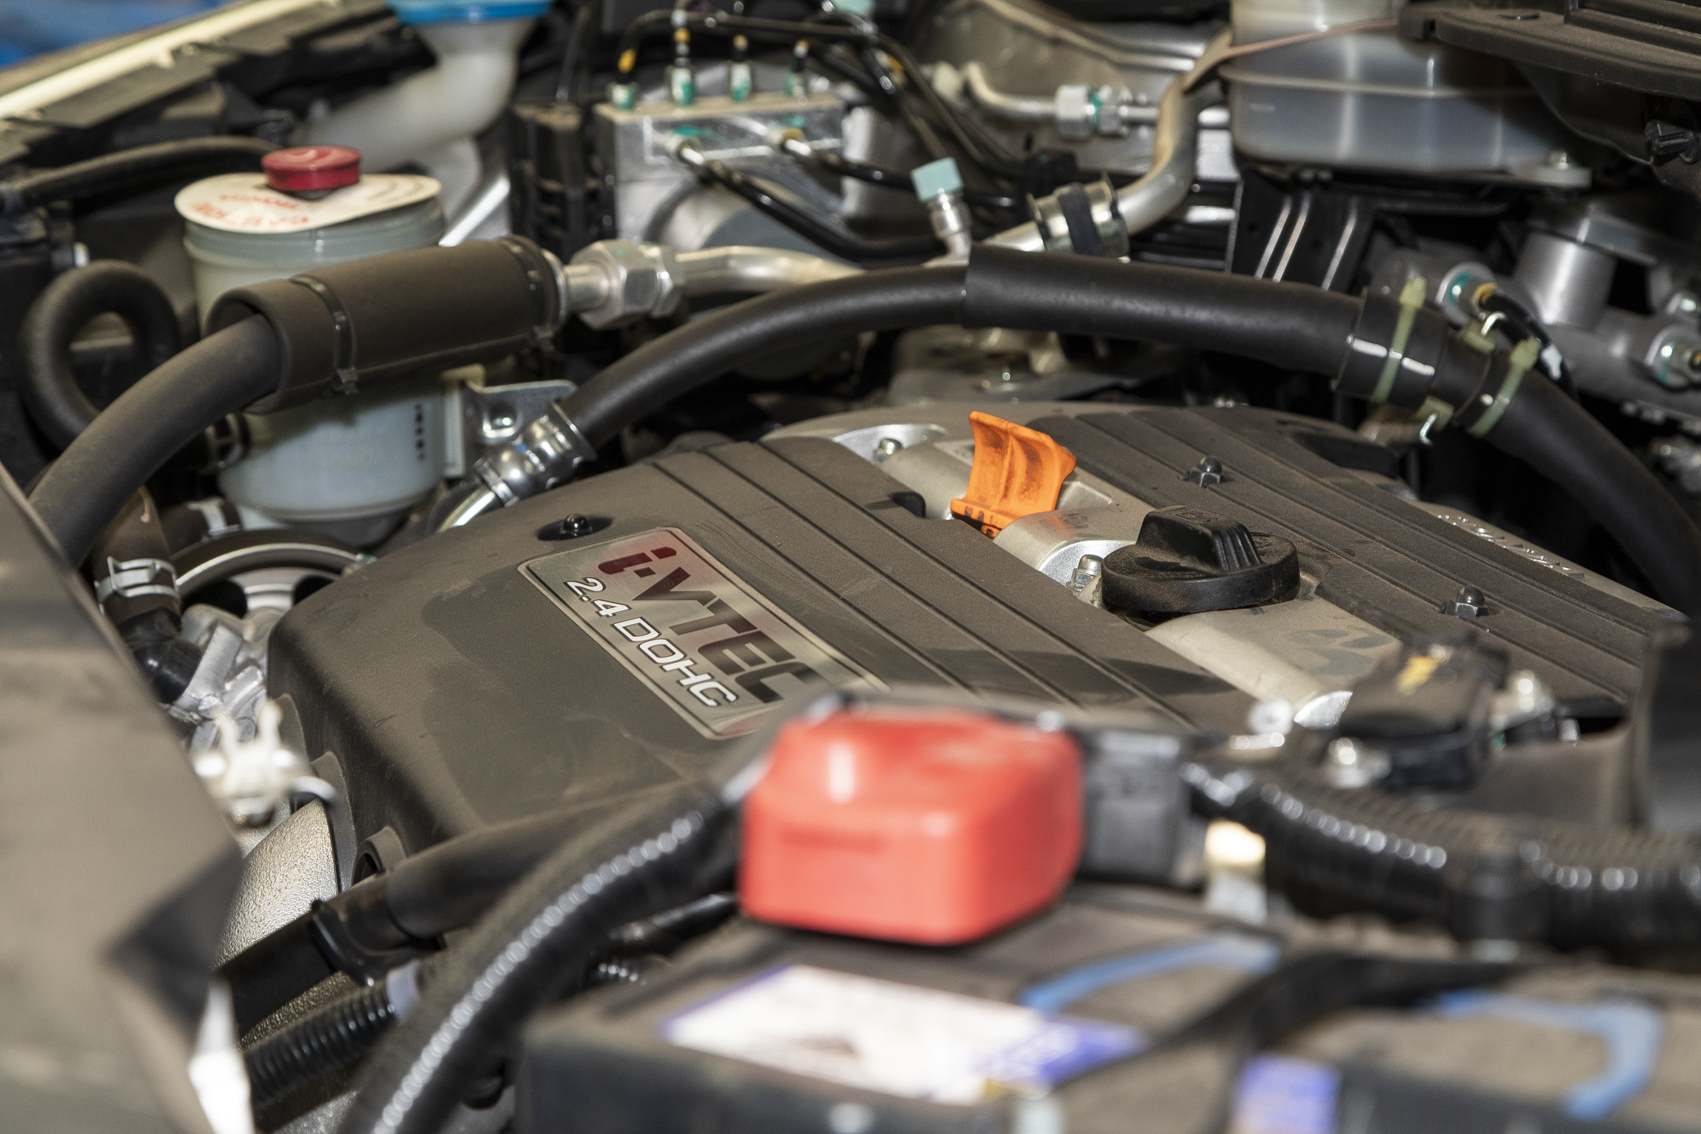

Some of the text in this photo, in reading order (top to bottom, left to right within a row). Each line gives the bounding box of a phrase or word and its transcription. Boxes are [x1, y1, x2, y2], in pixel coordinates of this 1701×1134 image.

[565, 576, 739, 707] 2.4 DOHC
[598, 547, 829, 704] i-VTEC
